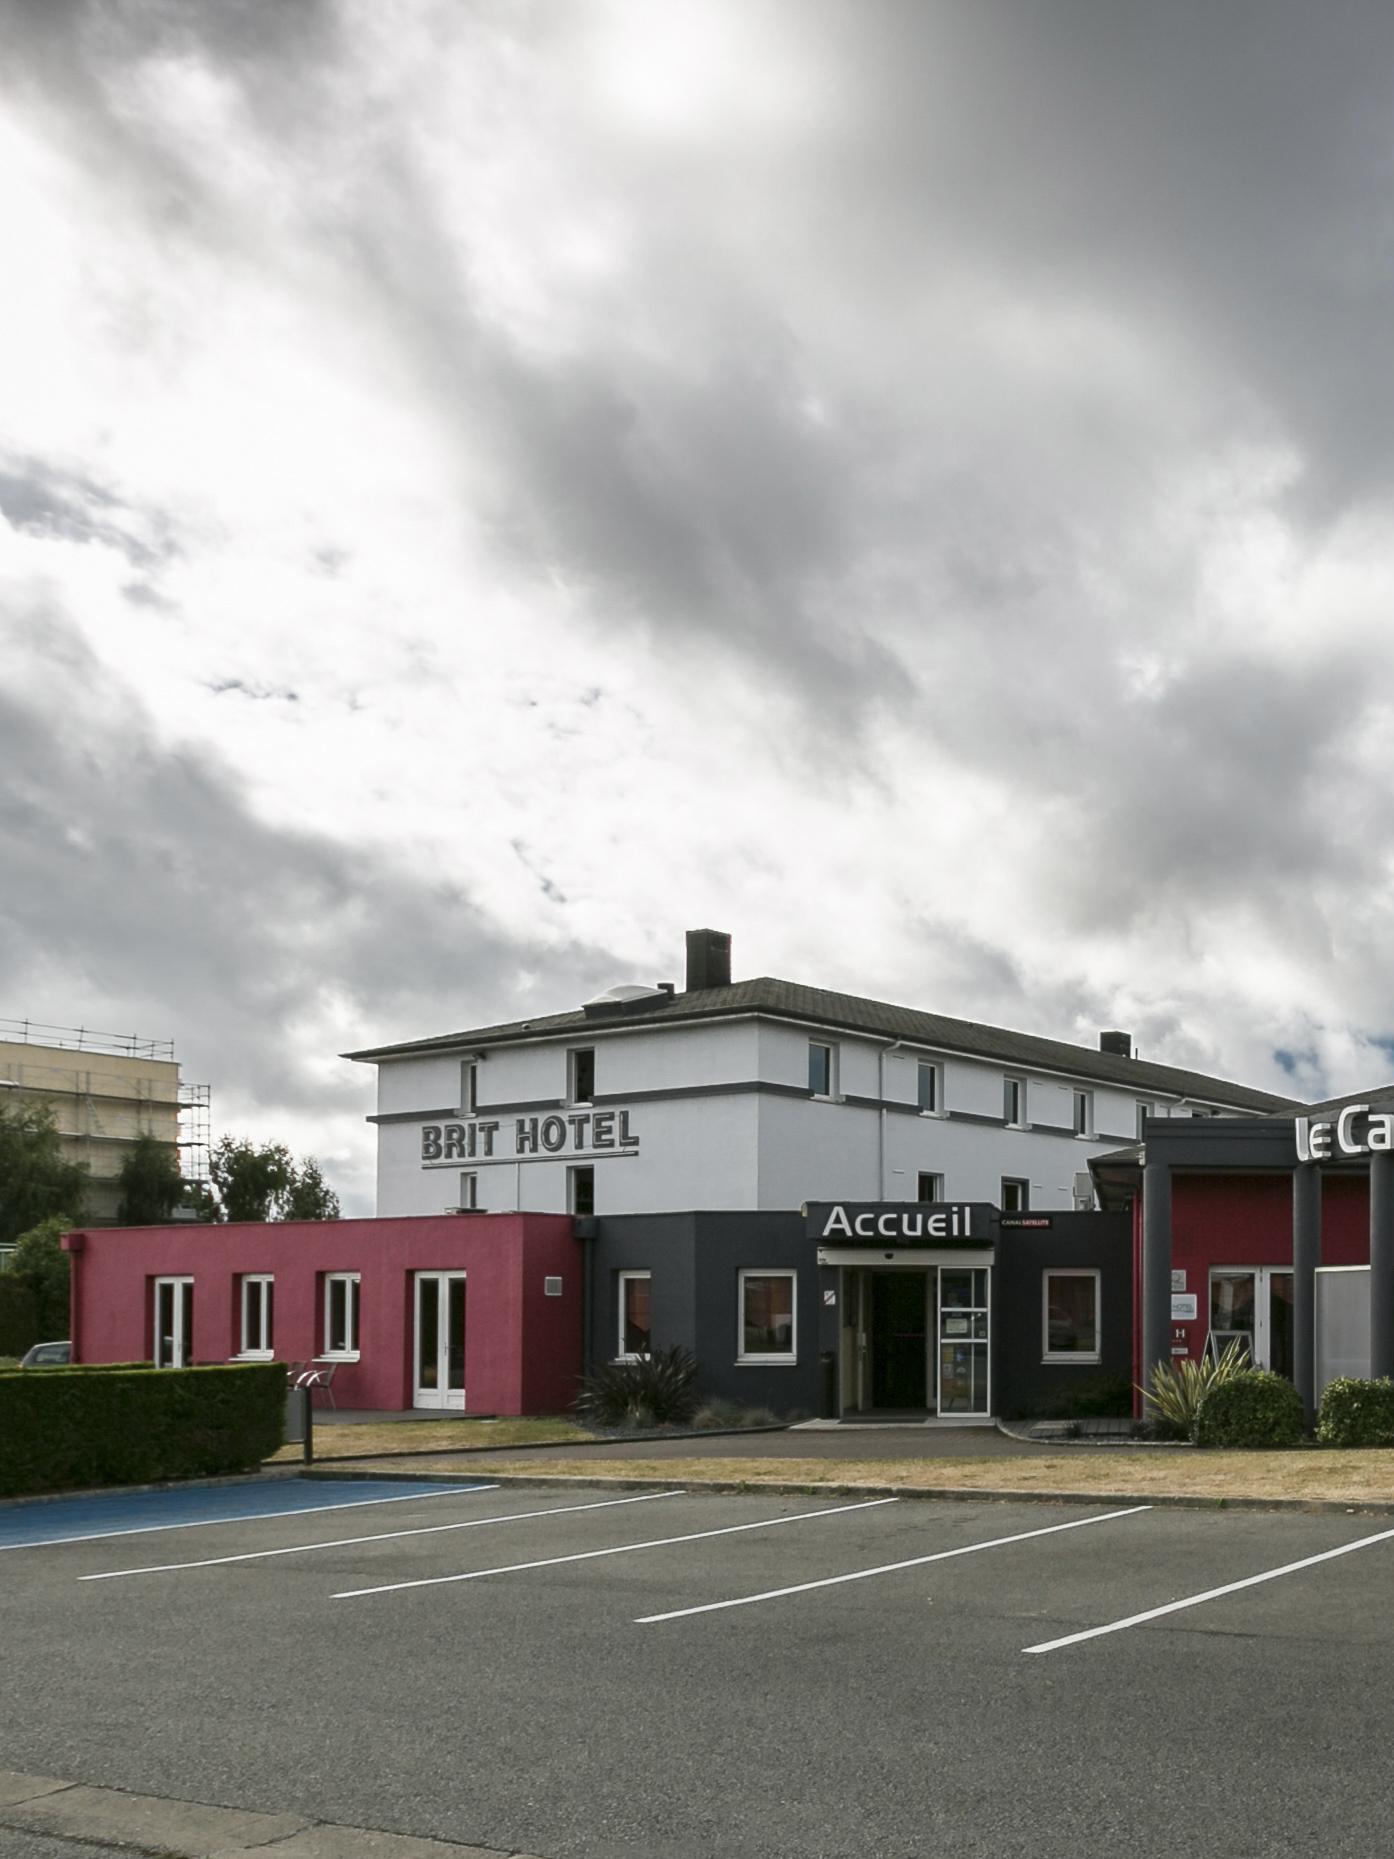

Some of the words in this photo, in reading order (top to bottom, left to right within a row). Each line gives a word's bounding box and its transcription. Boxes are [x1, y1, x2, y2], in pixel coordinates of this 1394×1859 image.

[421, 1121, 499, 1160] BRIT
[516, 1110, 639, 1154] HOTEL
[822, 1206, 971, 1237] Accueil
[1175, 1328, 1185, 1338] H
